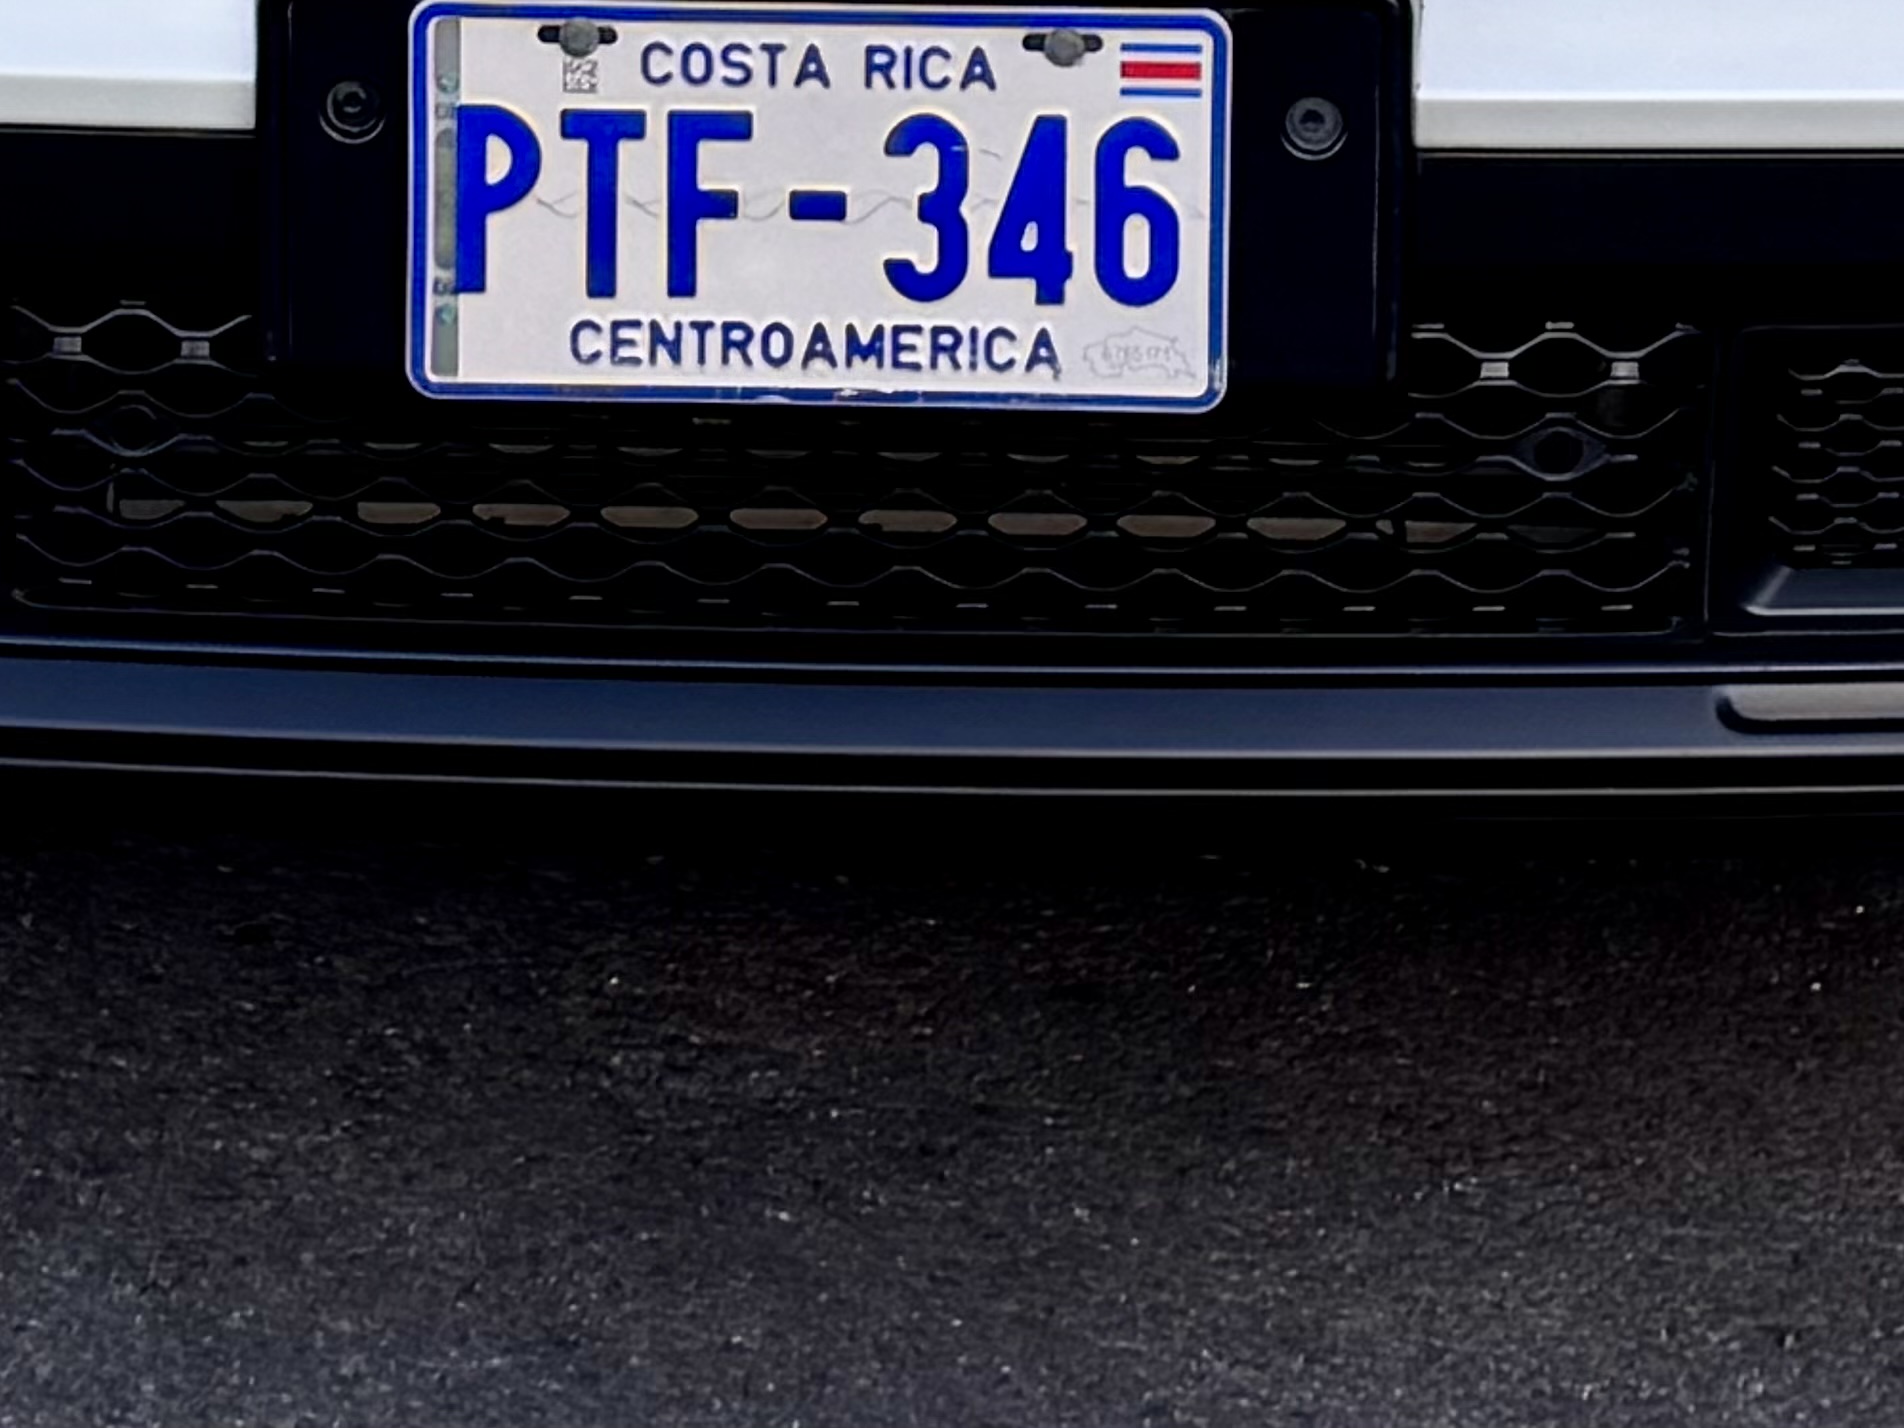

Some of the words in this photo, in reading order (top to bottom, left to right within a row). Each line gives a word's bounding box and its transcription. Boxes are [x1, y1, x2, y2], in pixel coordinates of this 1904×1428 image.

[639, 40, 832, 90] COSTA
[863, 45, 998, 93] RICA
[457, 103, 1182, 308] PTF-346
[568, 319, 1062, 375] CENTROAMERICA
